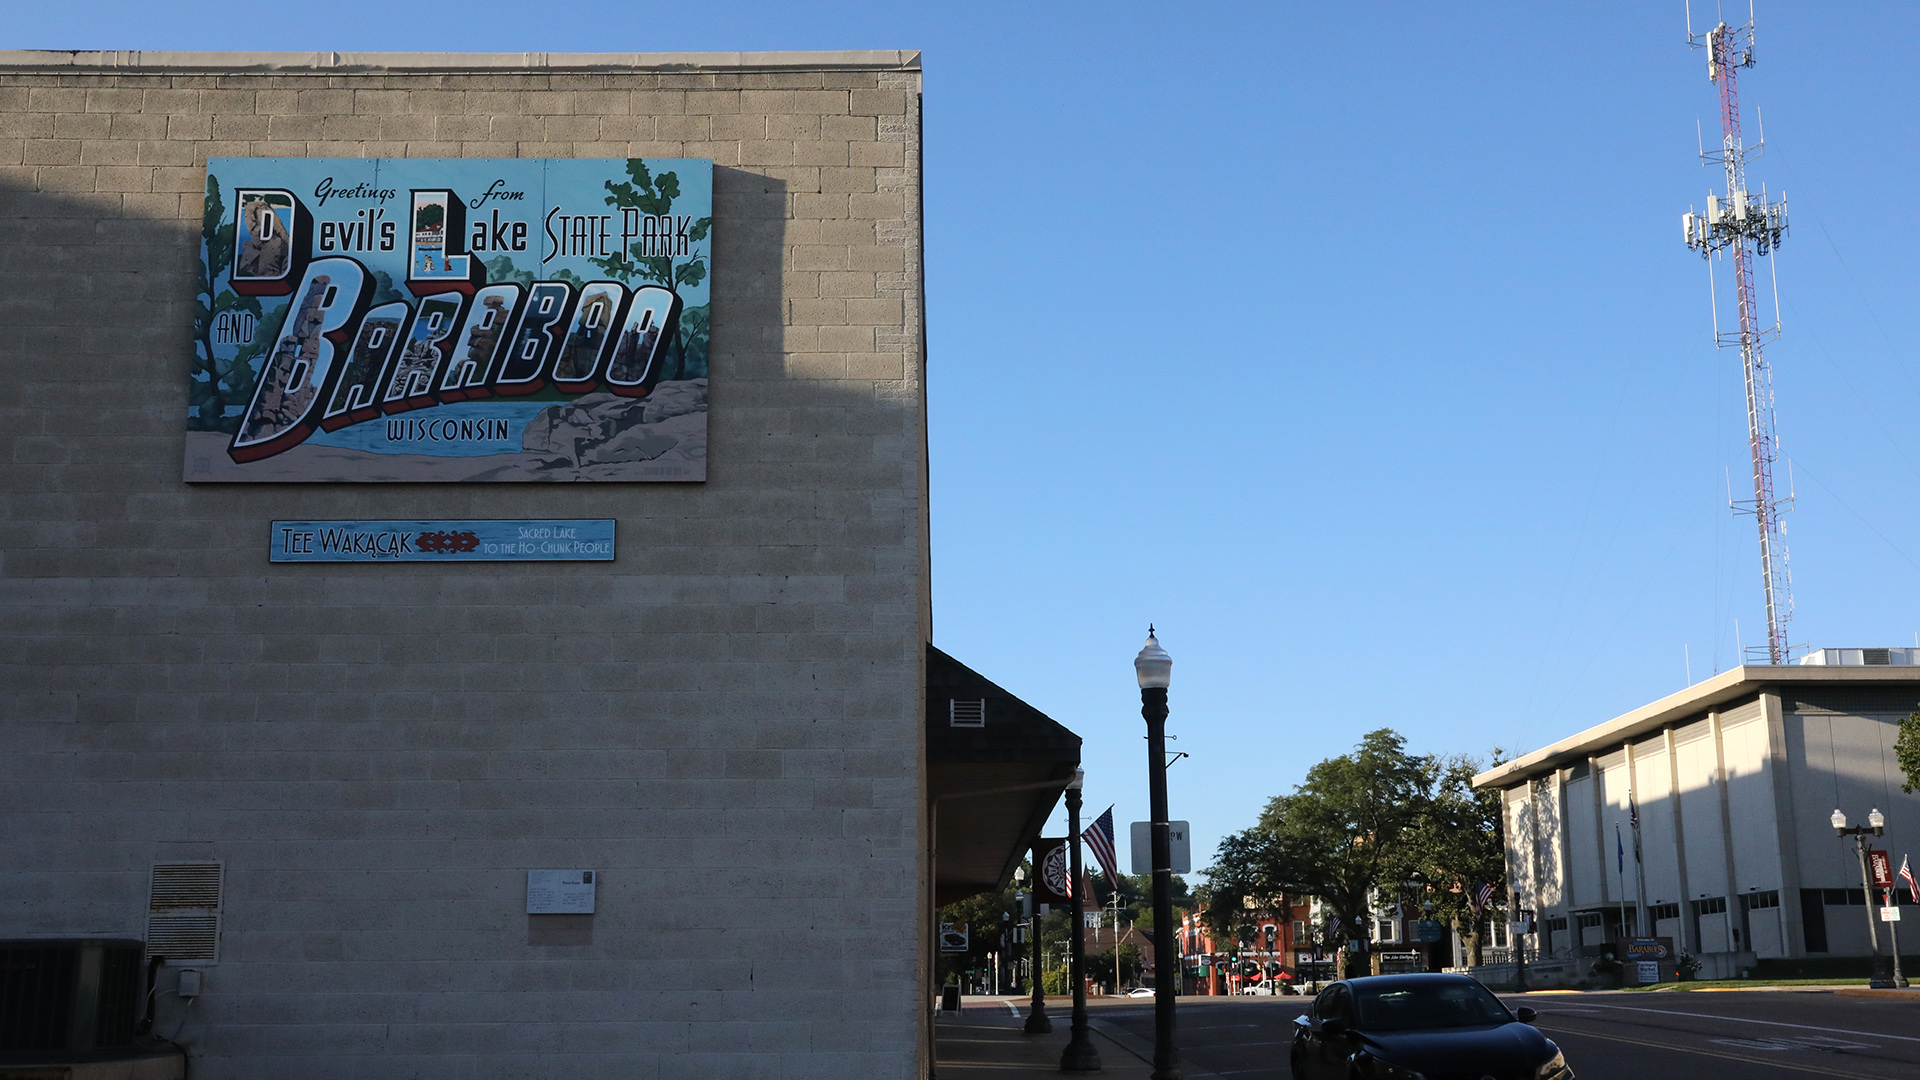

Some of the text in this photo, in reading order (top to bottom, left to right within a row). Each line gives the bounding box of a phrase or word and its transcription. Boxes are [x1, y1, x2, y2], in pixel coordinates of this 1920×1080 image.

[314, 176, 525, 210] Greetings from
[229, 187, 692, 294] Devil's Lake STATE PARK
[216, 311, 254, 345] AND
[229, 257, 684, 464] BARABOO
[386, 418, 510, 442] WISCONSIN
[281, 528, 314, 554] TEE
[484, 541, 610, 554] TO THE HO-CHUNK PEOPLE
[518, 526, 577, 539] SACRED LAKE
